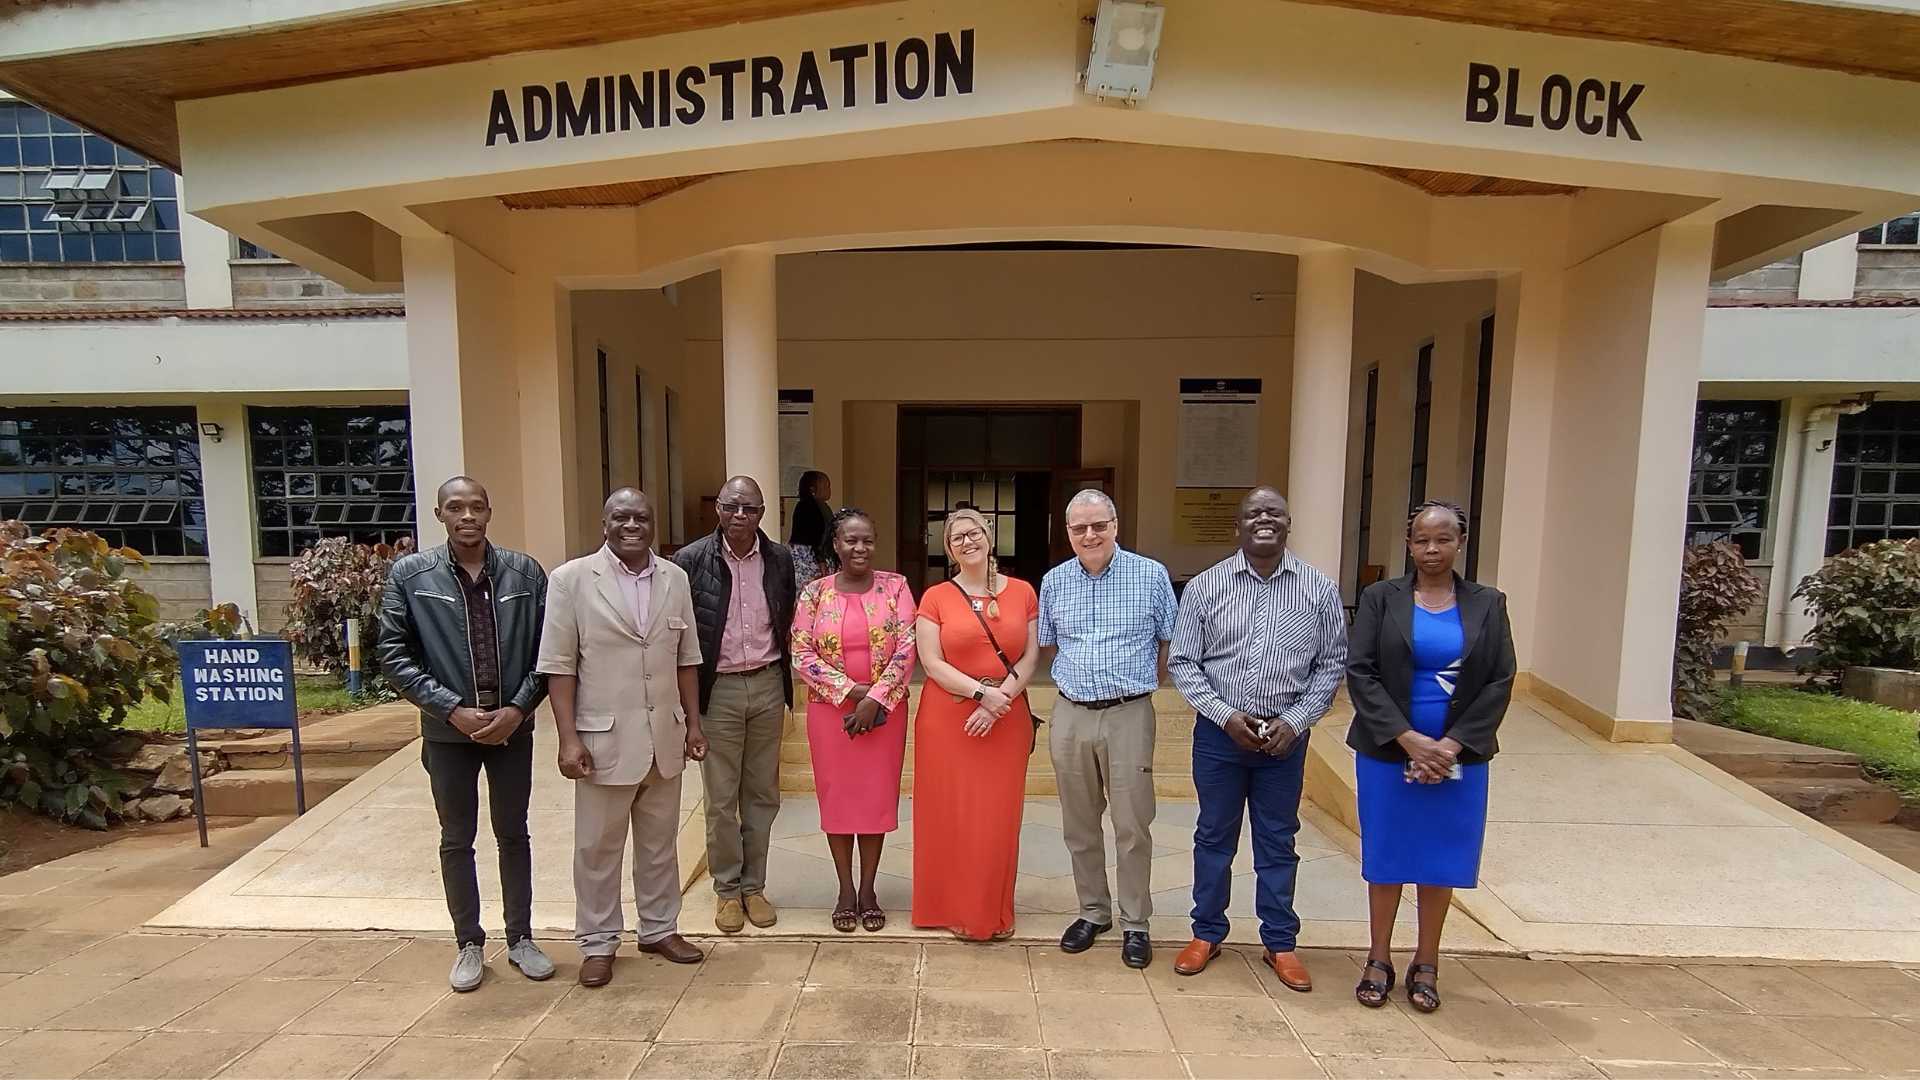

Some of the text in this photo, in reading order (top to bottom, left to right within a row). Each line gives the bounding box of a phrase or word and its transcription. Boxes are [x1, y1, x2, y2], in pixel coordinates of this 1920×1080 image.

[486, 28, 1646, 147] ADMINISTRATION BLOCK
[204, 648, 260, 664] HAND
[194, 668, 284, 683] WASHING
[195, 686, 284, 702] STATION
